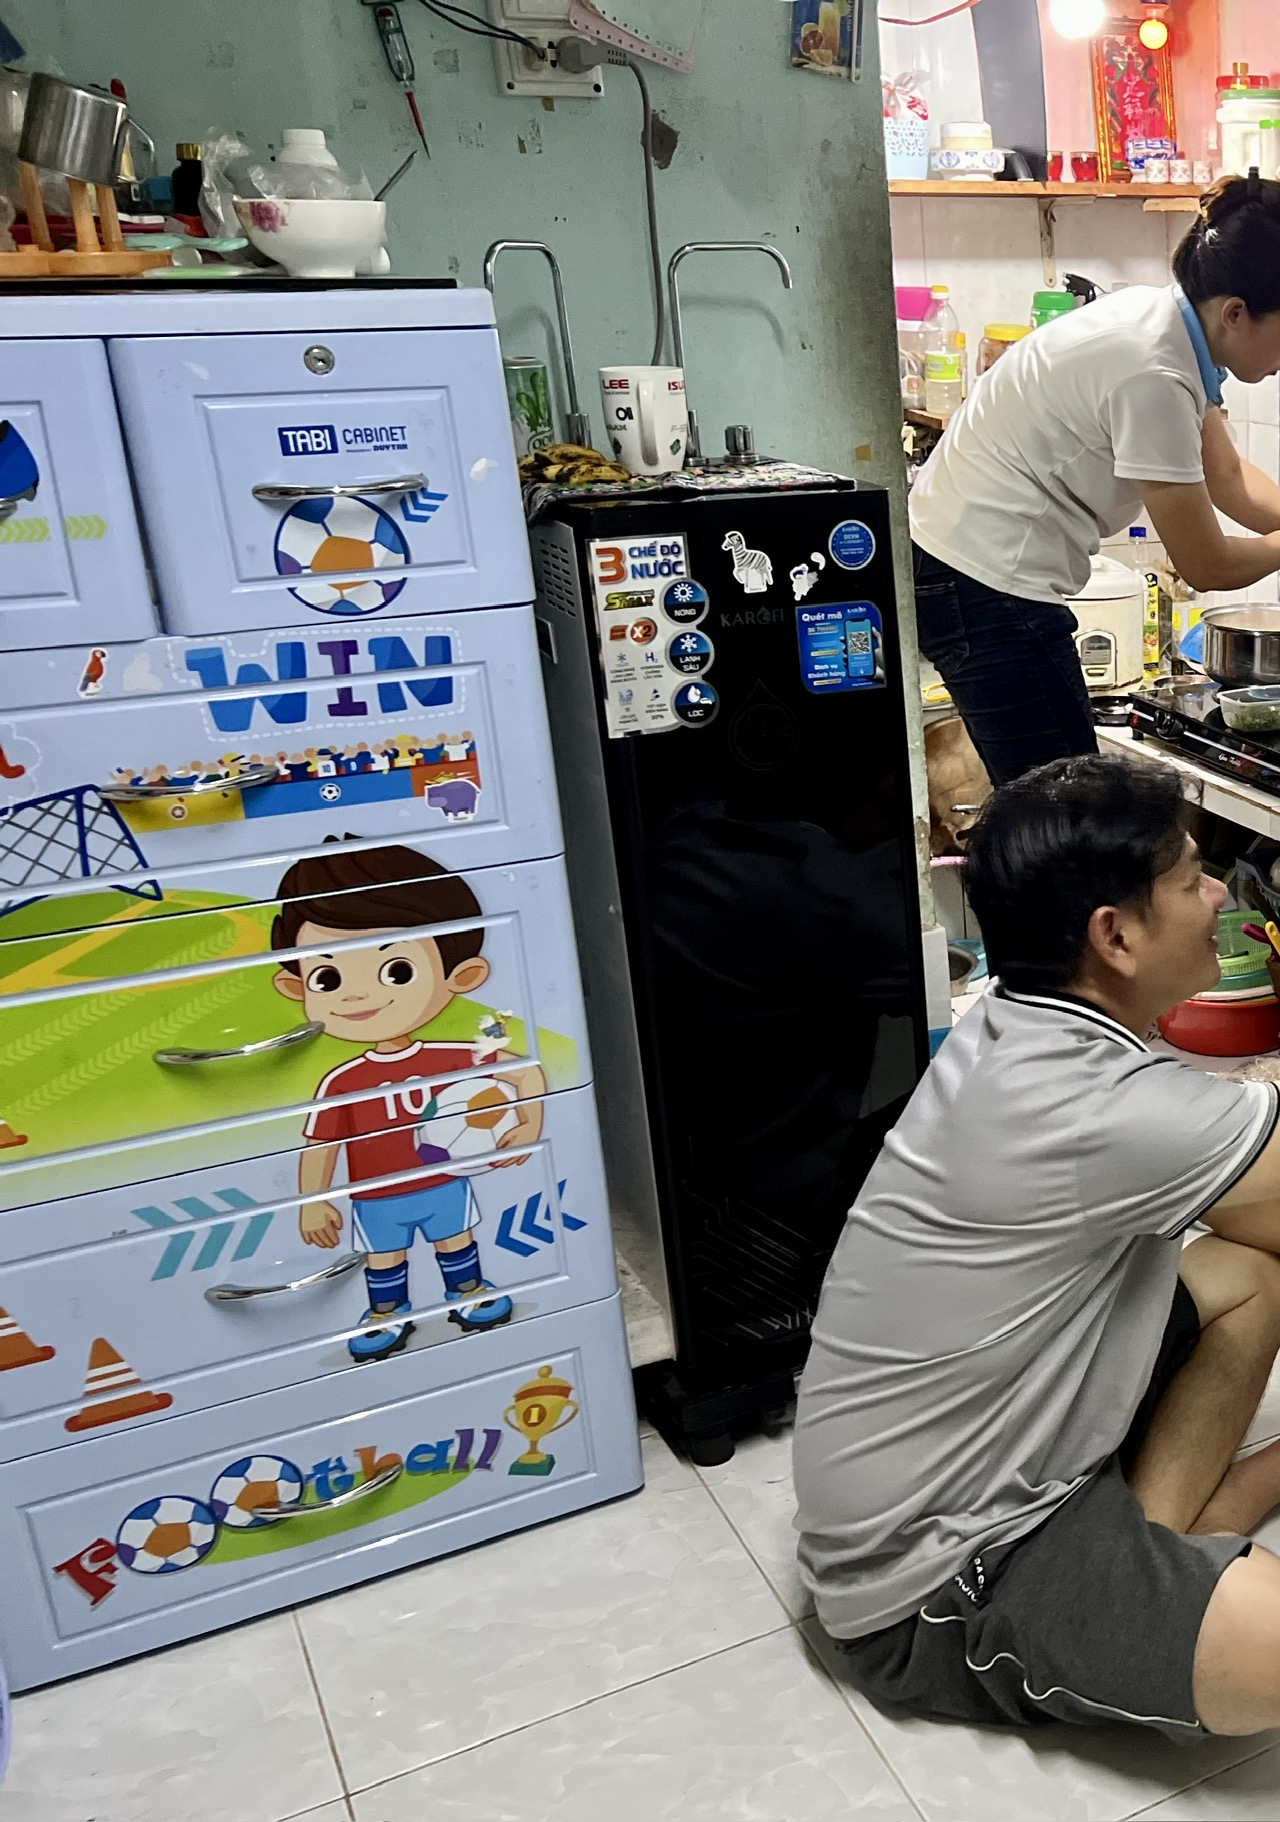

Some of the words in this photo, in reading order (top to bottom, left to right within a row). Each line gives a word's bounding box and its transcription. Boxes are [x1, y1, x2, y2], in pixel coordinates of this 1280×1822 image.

[282, 429, 332, 453] TABI
[342, 425, 407, 445] CABINET
[628, 541, 658, 559] CHẾ
[595, 547, 627, 585] 3
[802, 612, 825, 622] Quét
[185, 635, 454, 732] WIN
[377, 1074, 432, 1120] 10
